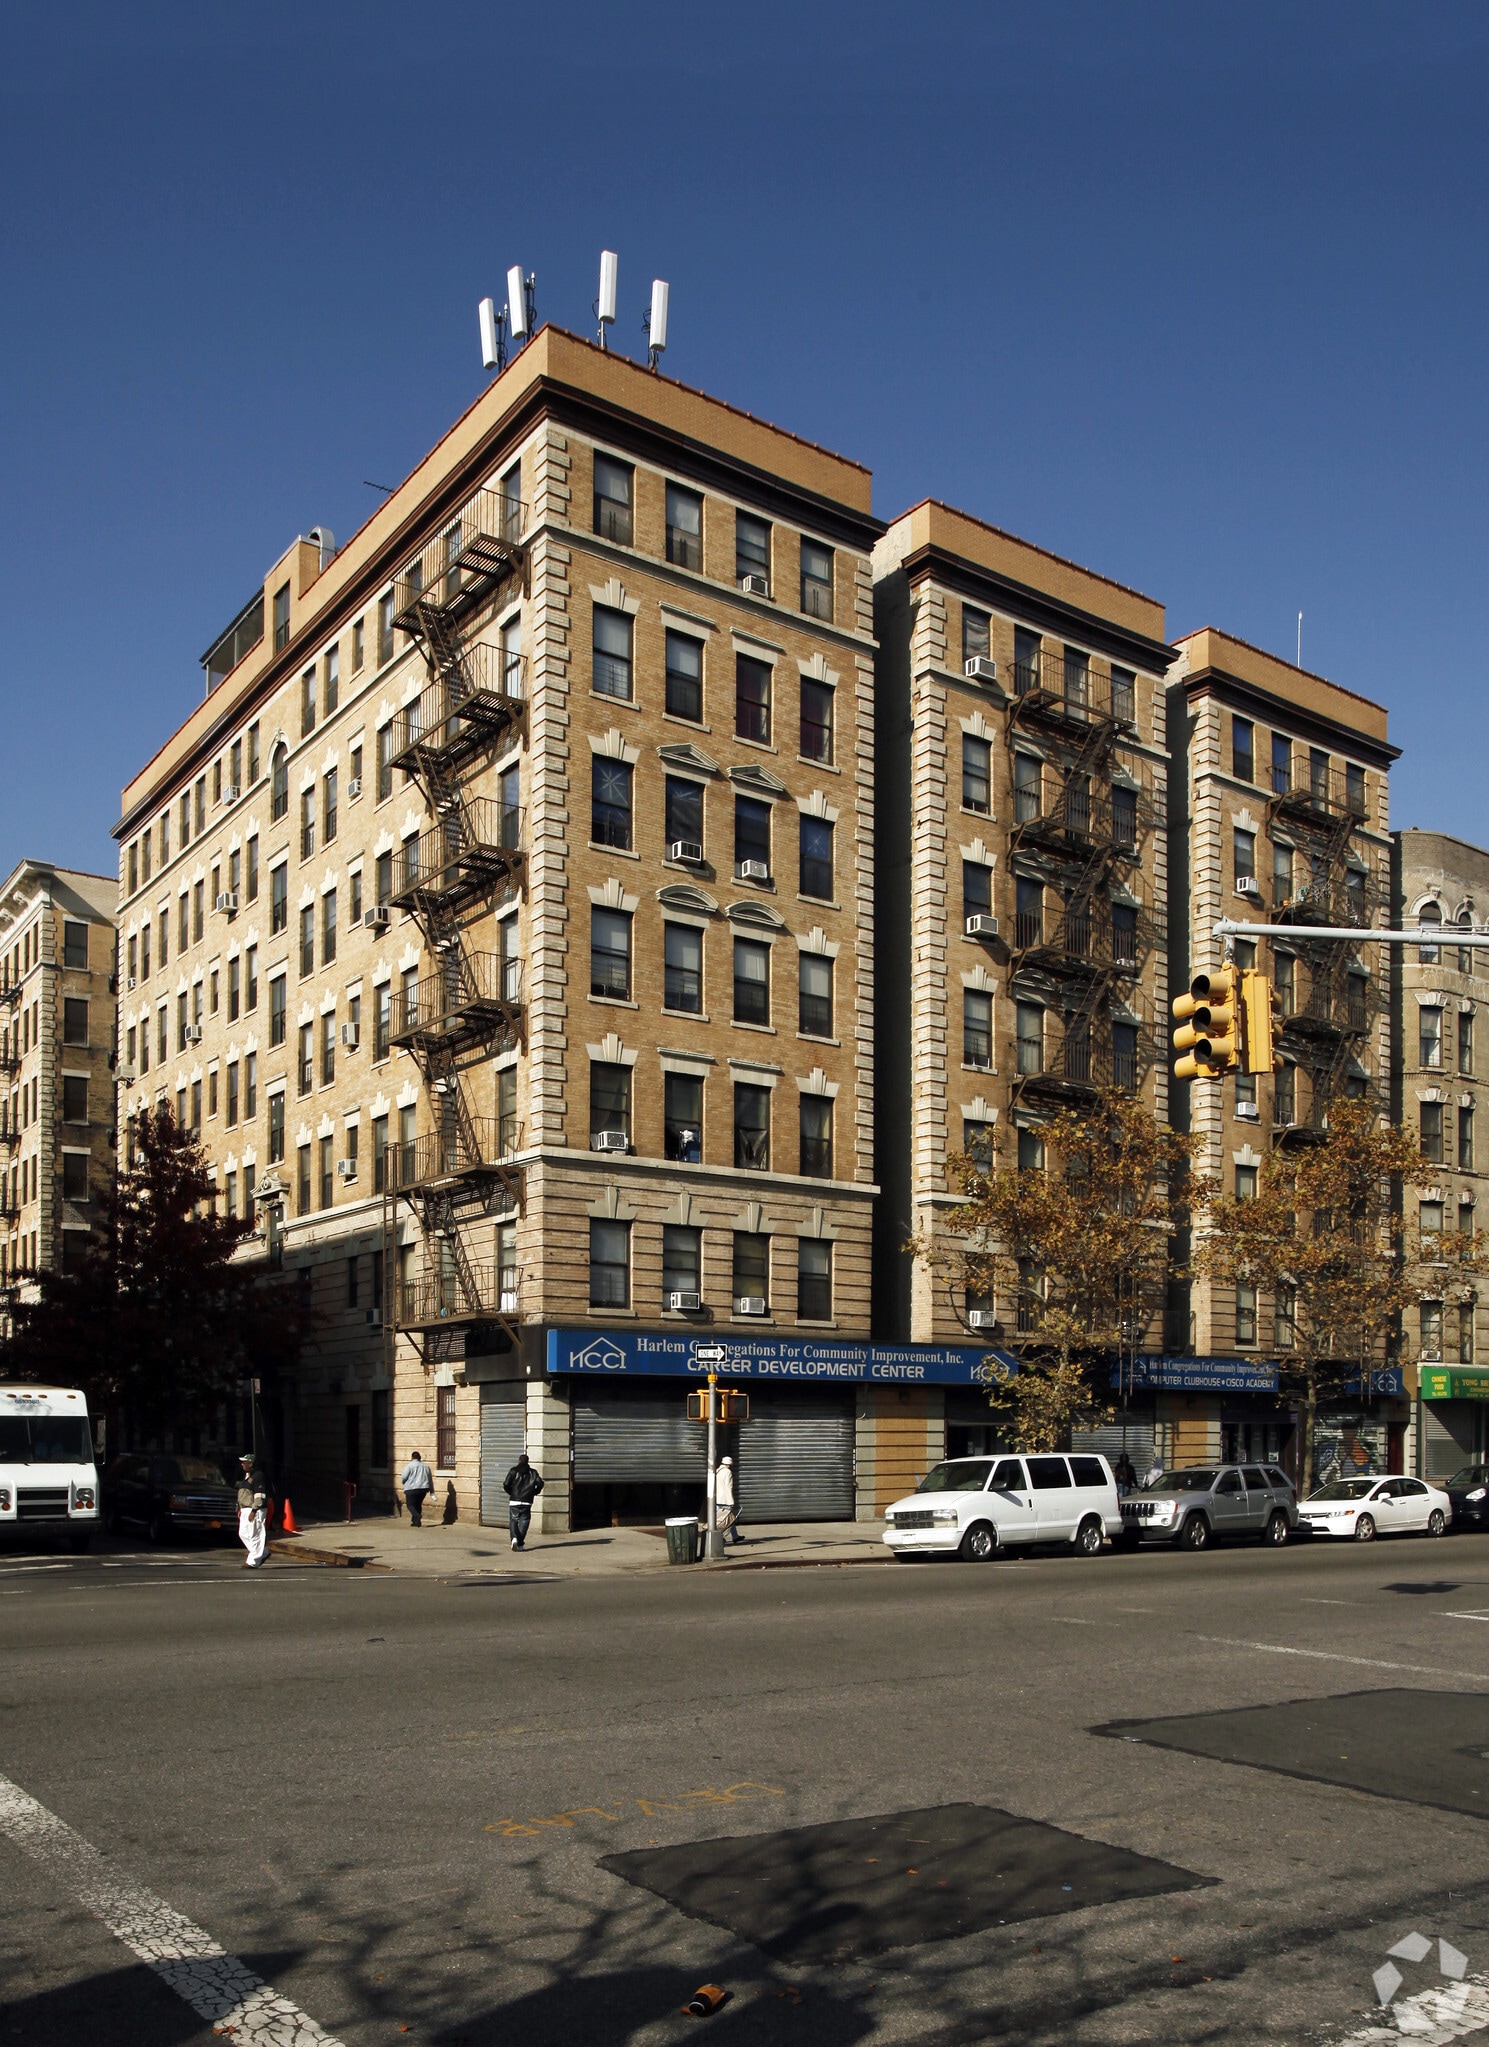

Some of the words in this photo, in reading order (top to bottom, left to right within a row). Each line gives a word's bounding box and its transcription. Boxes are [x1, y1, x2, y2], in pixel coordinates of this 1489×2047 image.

[637, 1338, 685, 1353] Harlem
[688, 1340, 776, 1359] Cegations
[779, 1344, 800, 1358] For
[803, 1345, 868, 1363] Community
[871, 1348, 944, 1365] Improvement,
[946, 1351, 964, 1364] Inc.
[700, 1350, 709, 1358] ONE
[713, 1350, 722, 1358] WAY
[758, 1359, 866, 1377] DEVELOPMENT
[871, 1364, 925, 1379] CENTER
[1184, 1376, 1221, 1387] CLUBHOUSE
[1225, 1378, 1244, 1387] CISCO
[1246, 1379, 1275, 1389] ACADEMY
